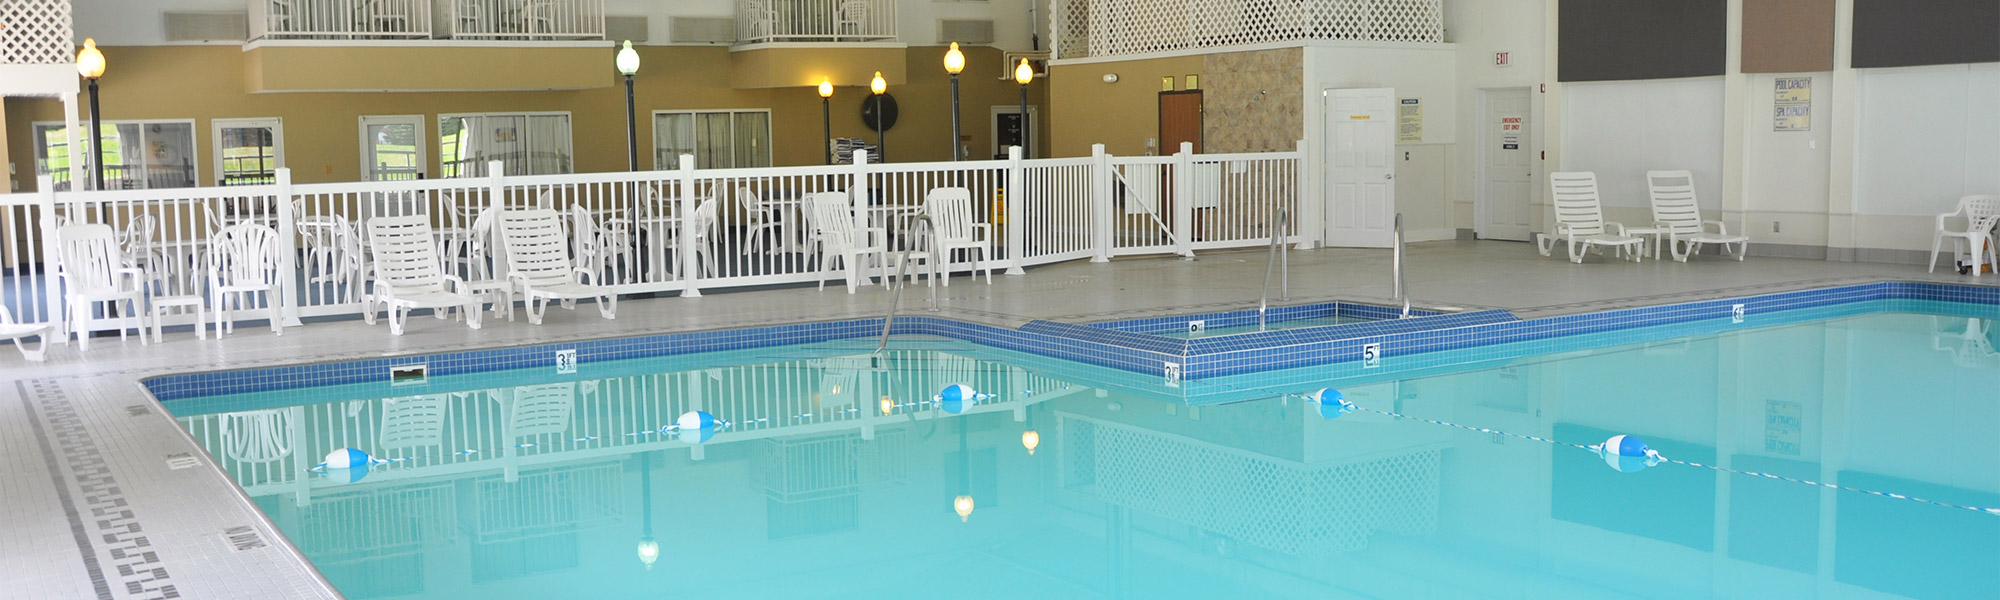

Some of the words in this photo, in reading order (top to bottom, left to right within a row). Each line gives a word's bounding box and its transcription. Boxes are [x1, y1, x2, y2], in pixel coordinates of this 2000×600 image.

[1496, 52, 1509, 65] EXIT
[1776, 80, 1787, 90] POOL
[1788, 79, 1810, 89] CAPACITY
[1776, 107, 1785, 117] SPA
[1786, 106, 1809, 117] CAPACITY
[1365, 345, 1374, 361] 5
